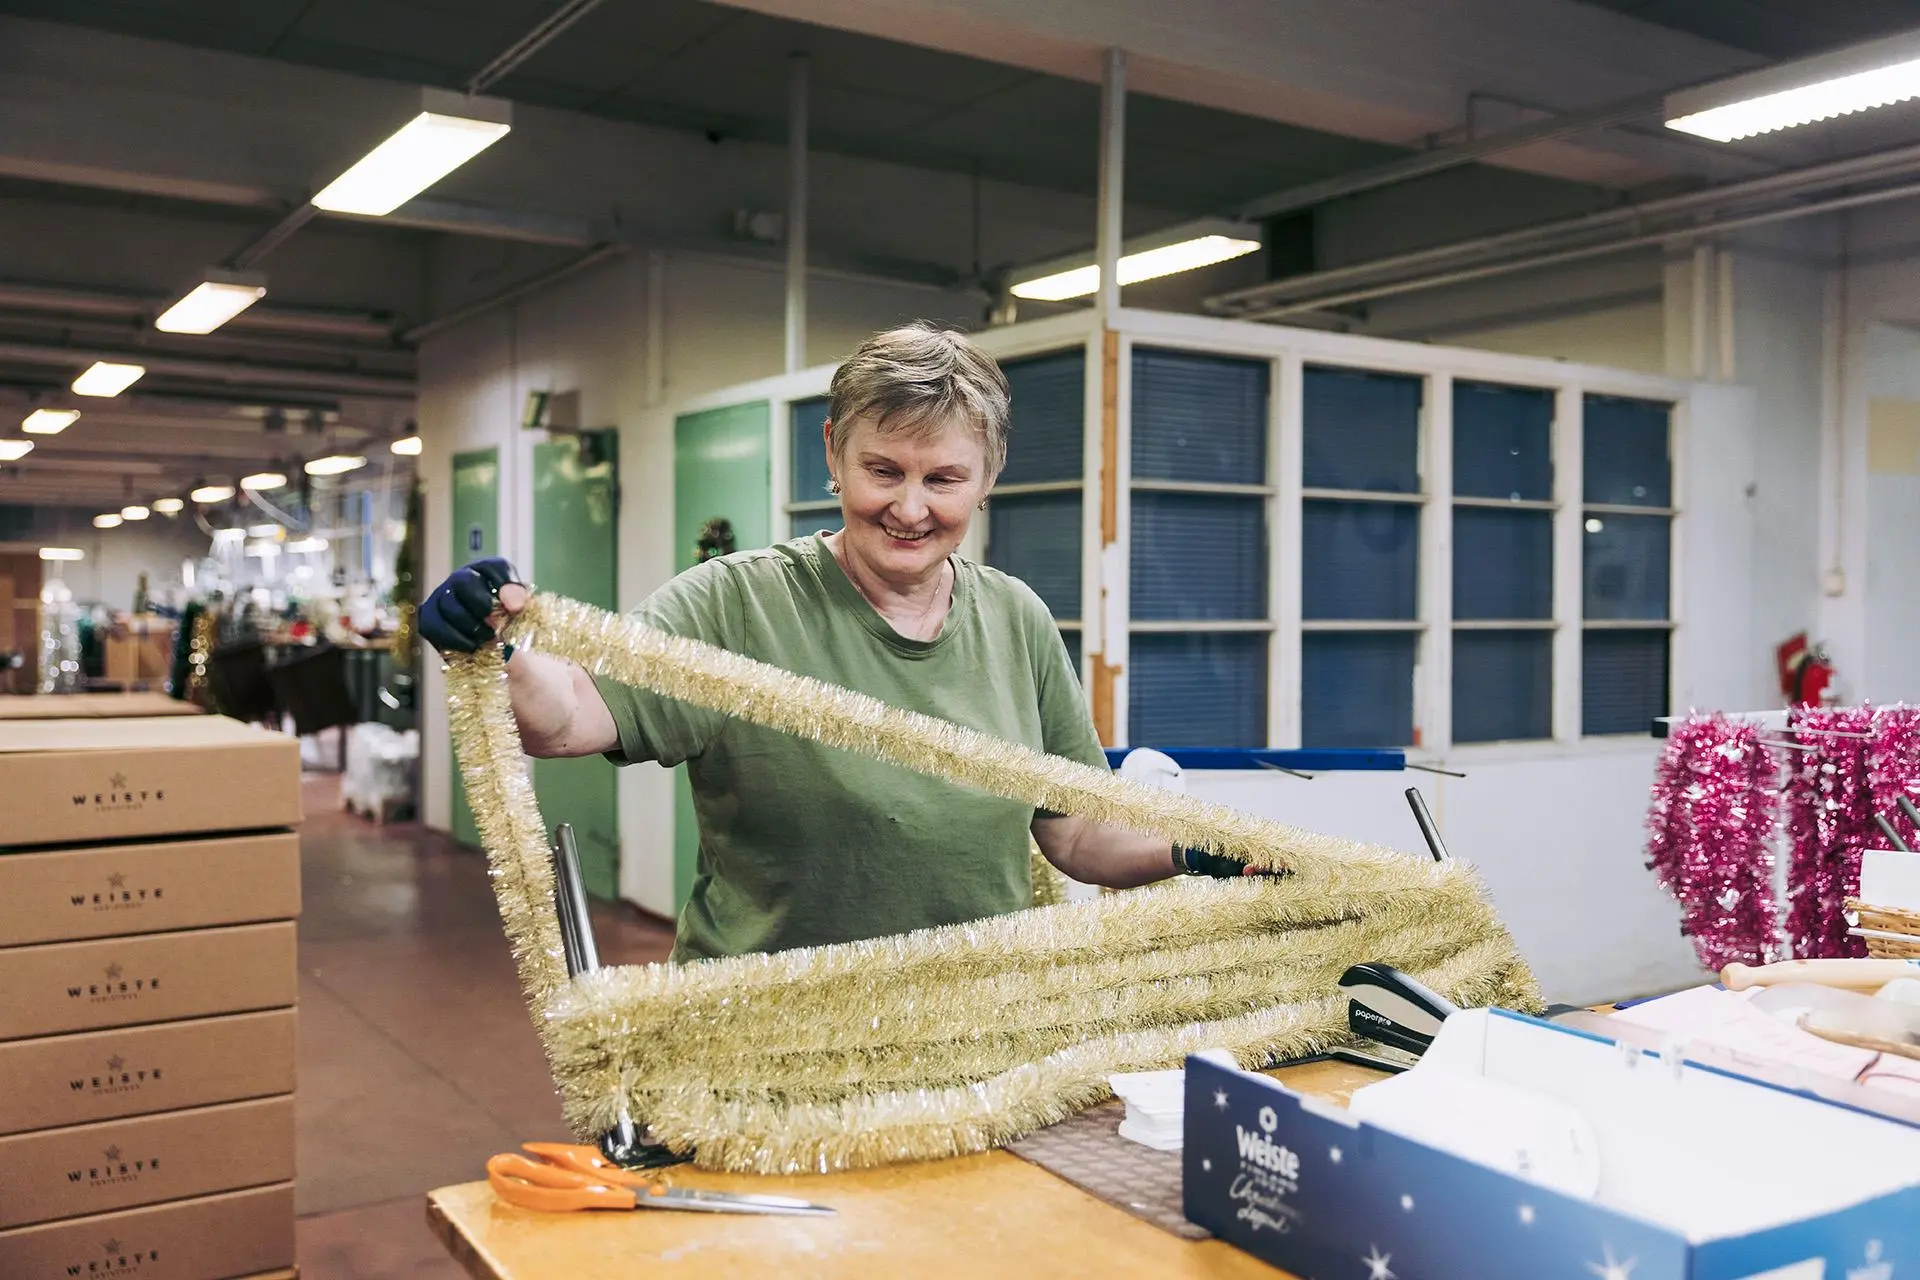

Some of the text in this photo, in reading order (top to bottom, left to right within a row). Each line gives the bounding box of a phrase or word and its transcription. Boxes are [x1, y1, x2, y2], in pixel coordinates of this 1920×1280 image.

[72, 790, 164, 806] WEISTE
[71, 888, 163, 906] WEISTE
[68, 978, 160, 998] WEISTE
[1355, 1009, 1392, 1026] paperpro
[70, 1069, 161, 1090] WEISTE
[1235, 1124, 1300, 1180] Weiste
[68, 1159, 159, 1181] WEISTE
[66, 1250, 158, 1276] WEISTE
